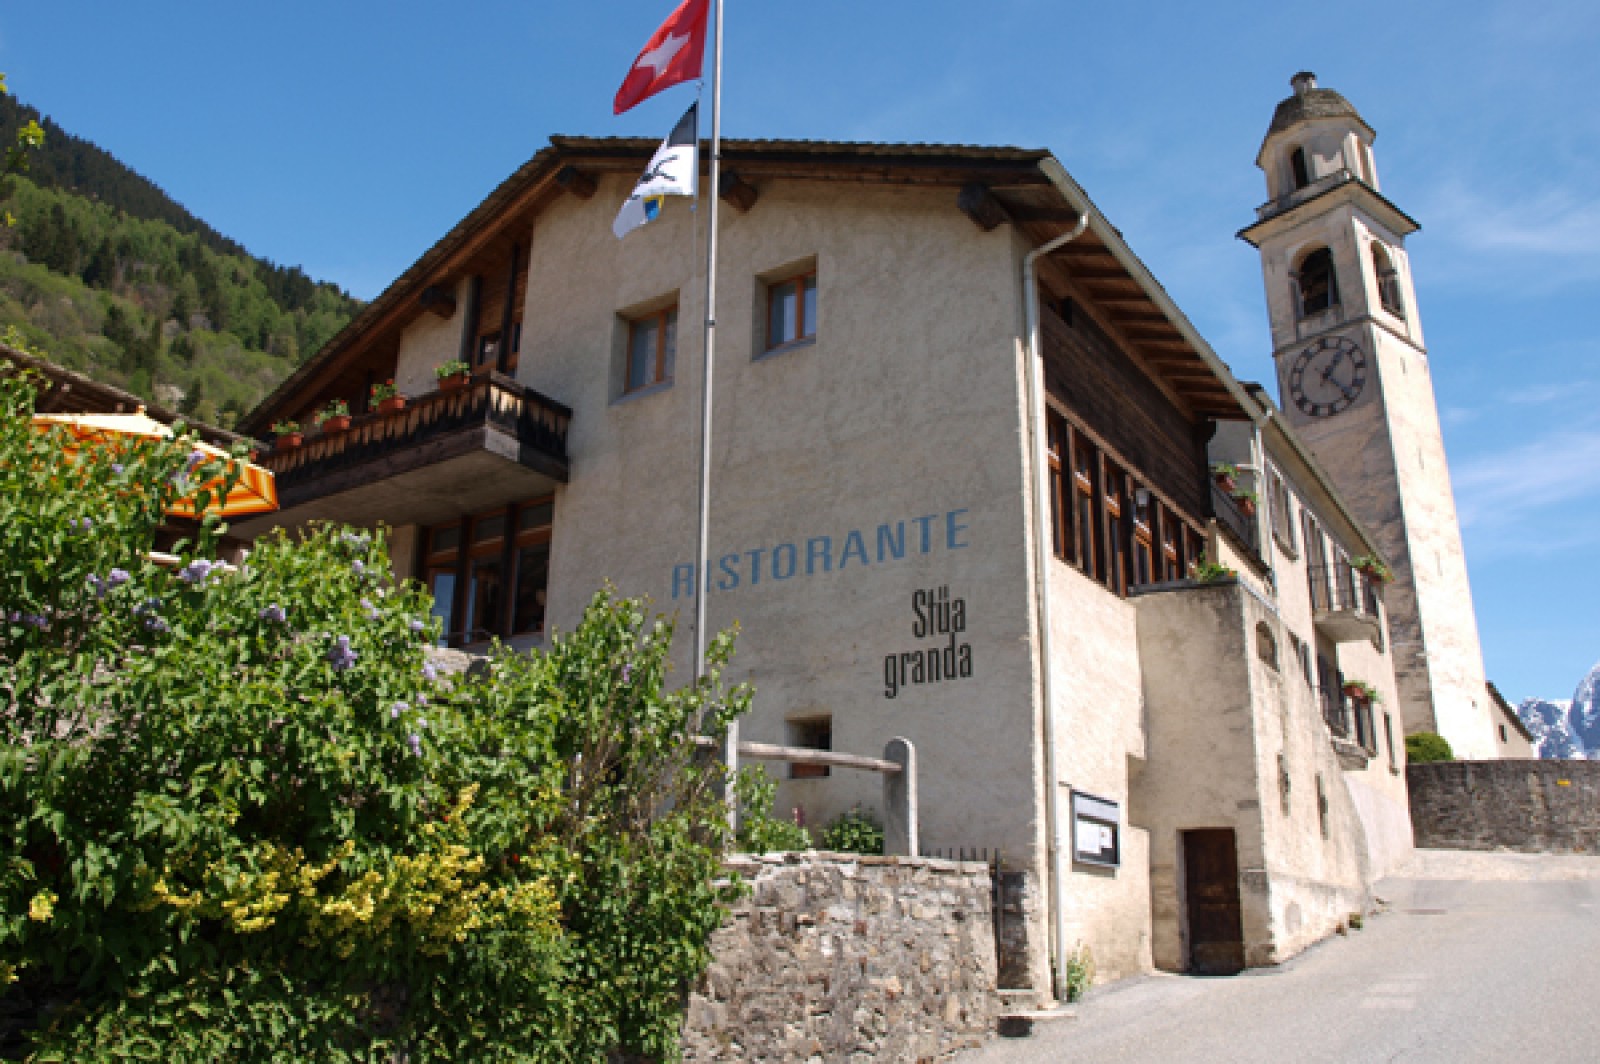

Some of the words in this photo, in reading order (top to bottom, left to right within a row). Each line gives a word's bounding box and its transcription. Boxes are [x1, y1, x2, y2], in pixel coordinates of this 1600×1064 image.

[671, 508, 969, 599] RISTORANTE
[912, 584, 966, 638] Stüa
[884, 632, 973, 699] granda
